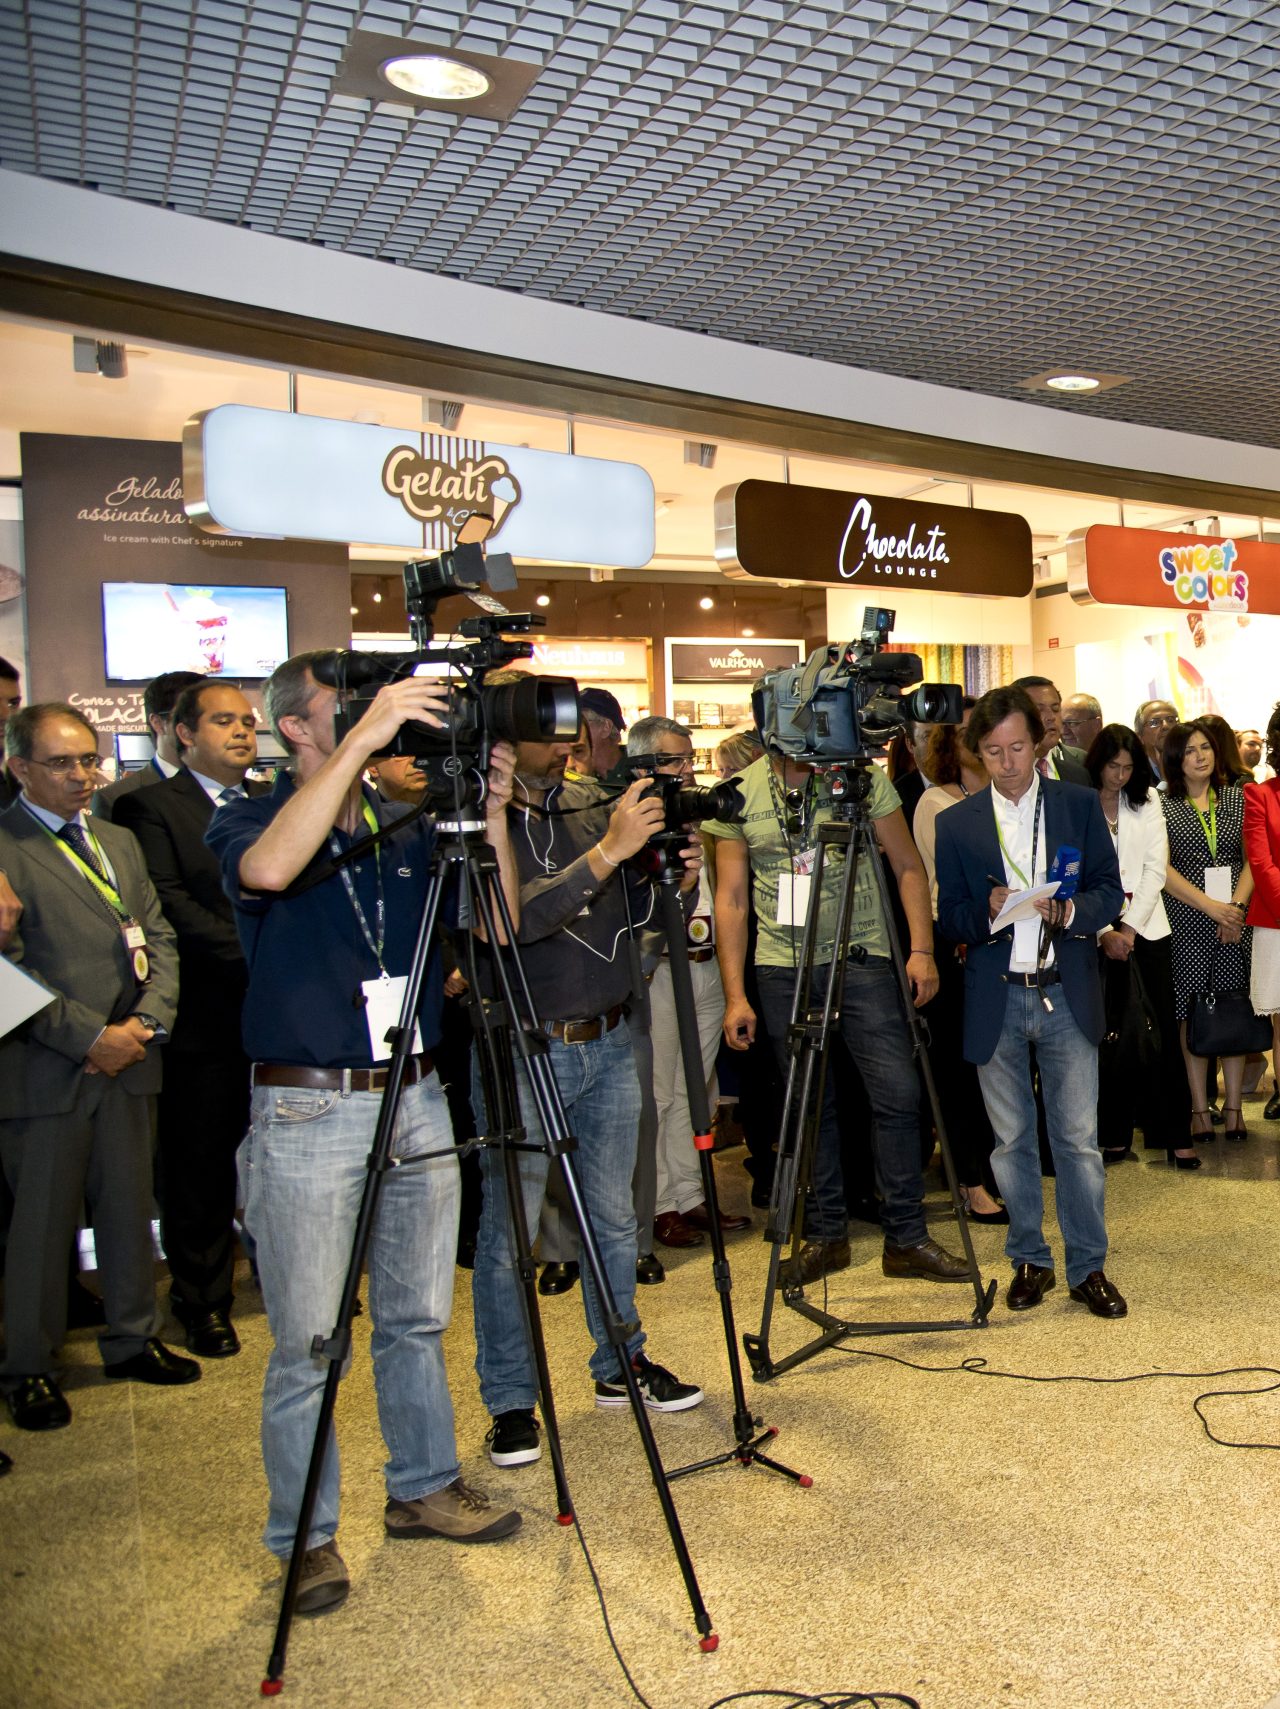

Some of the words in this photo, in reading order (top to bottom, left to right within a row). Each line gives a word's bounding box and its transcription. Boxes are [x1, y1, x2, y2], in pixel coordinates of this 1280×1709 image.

[105, 477, 184, 506] Gelado
[386, 449, 506, 518] Gelati
[77, 507, 186, 524] assinatura
[103, 534, 117, 542] Ice
[119, 536, 149, 544] cream
[150, 535, 170, 544] with
[171, 536, 200, 545] Chef's
[201, 538, 244, 547] signature
[874, 564, 937, 578] LOUNGE
[530, 644, 625, 666] Neuhaus
[708, 657, 764, 668] VALRHONA
